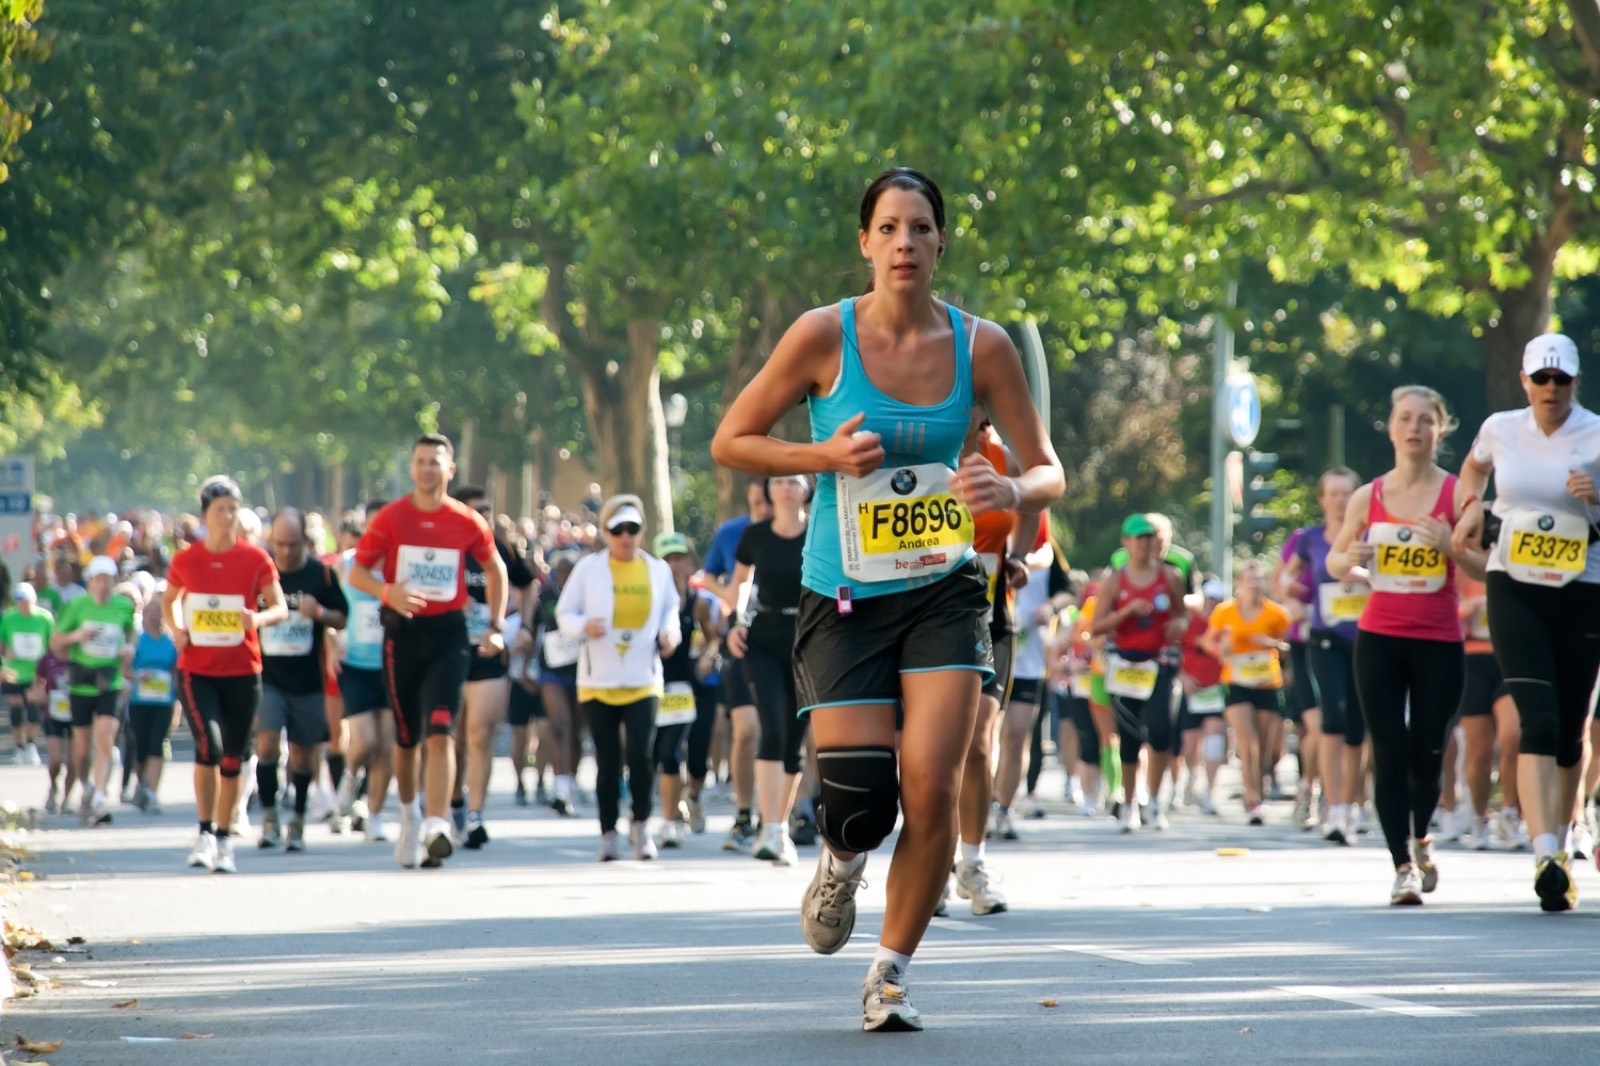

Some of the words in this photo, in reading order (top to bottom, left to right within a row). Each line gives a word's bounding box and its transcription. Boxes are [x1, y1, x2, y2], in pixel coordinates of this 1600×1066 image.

[859, 502, 868, 514] H
[872, 498, 962, 539] F8696
[898, 536, 940, 550] Andrea
[1518, 532, 1581, 562] F3373
[895, 559, 909, 570] be
[1383, 546, 1440, 568] F463
